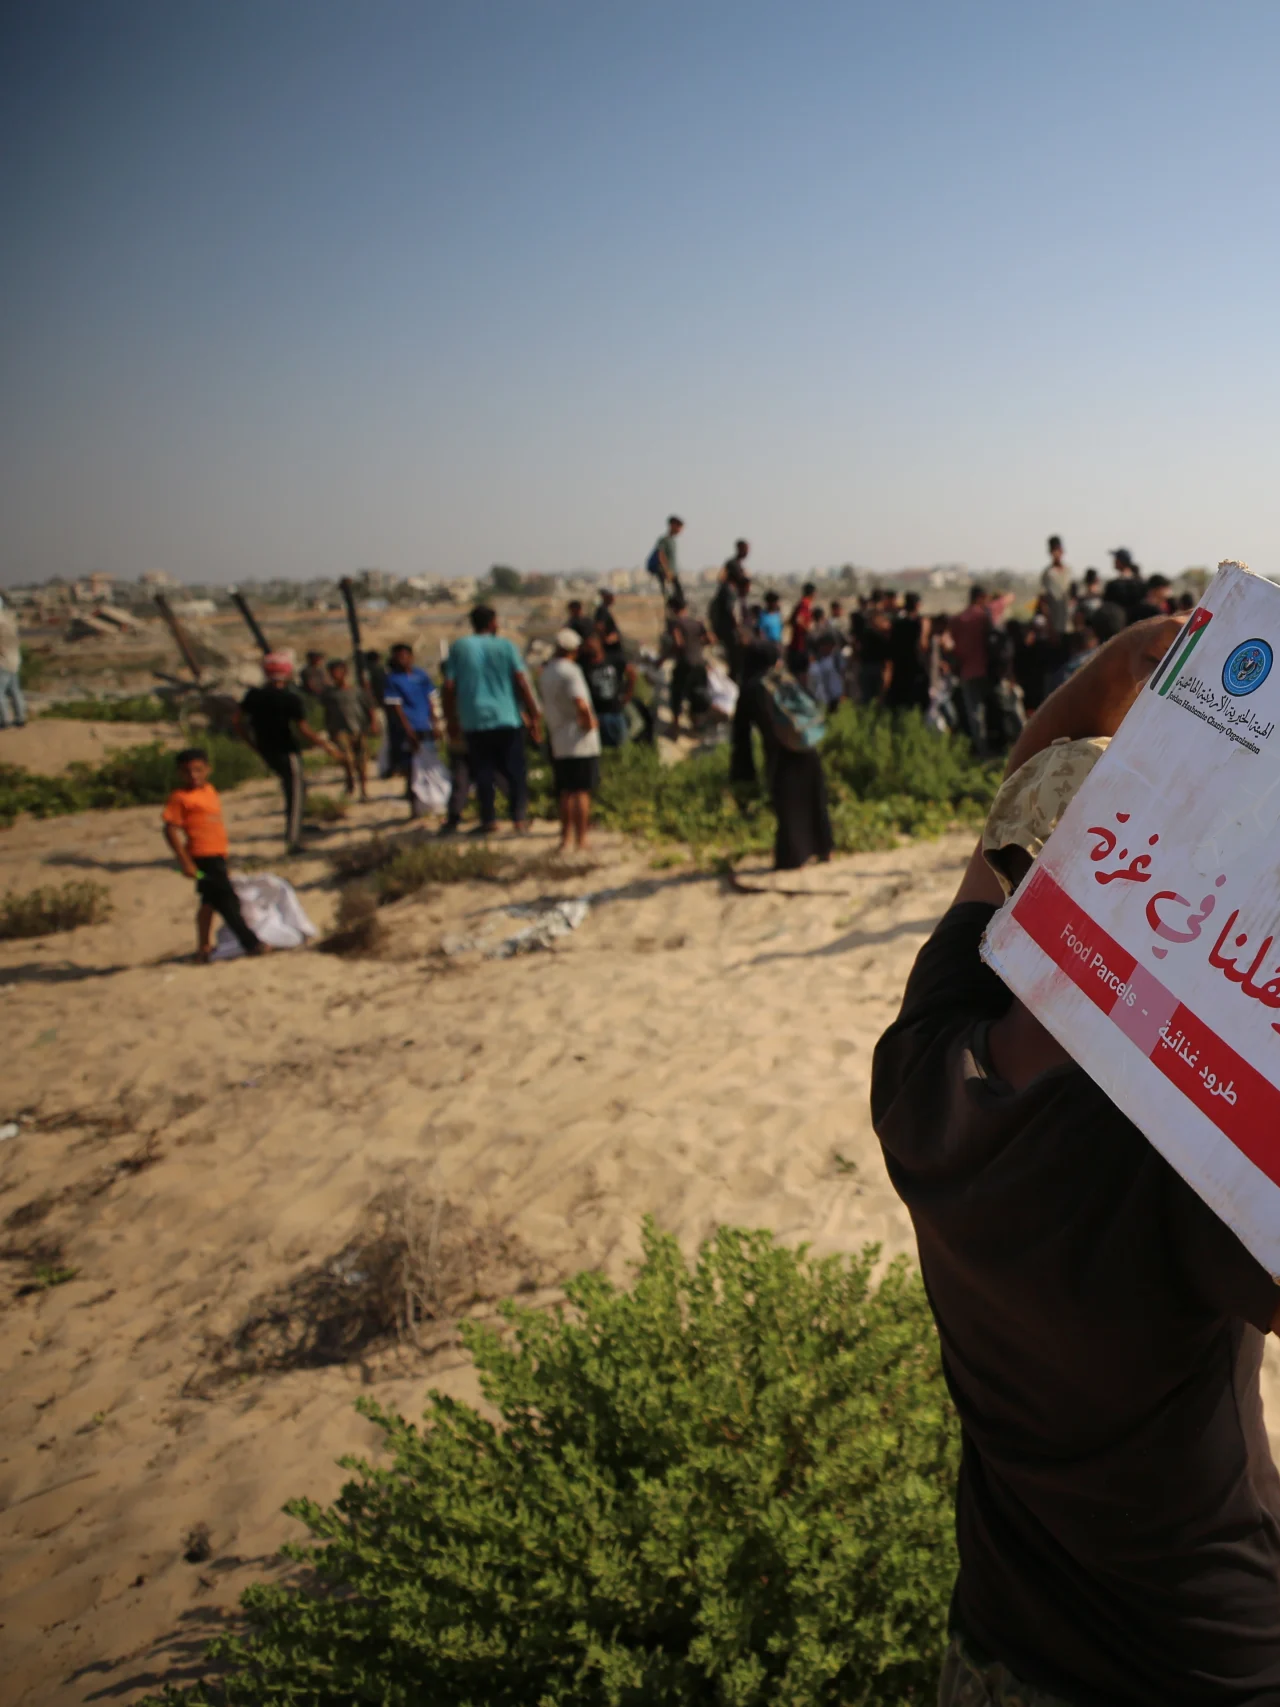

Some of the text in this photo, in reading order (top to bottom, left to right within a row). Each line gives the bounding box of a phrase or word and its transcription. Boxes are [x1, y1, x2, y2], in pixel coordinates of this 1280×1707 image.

[1166, 691, 1260, 754] Jordan Hashemite Charity Organization
[1087, 812, 1159, 885] غزة
[1145, 874, 1226, 959] في
[1060, 923, 1093, 962] Food
[1089, 953, 1137, 1006] Parcels
[1158, 1020, 1238, 1106] طرود غذائية
